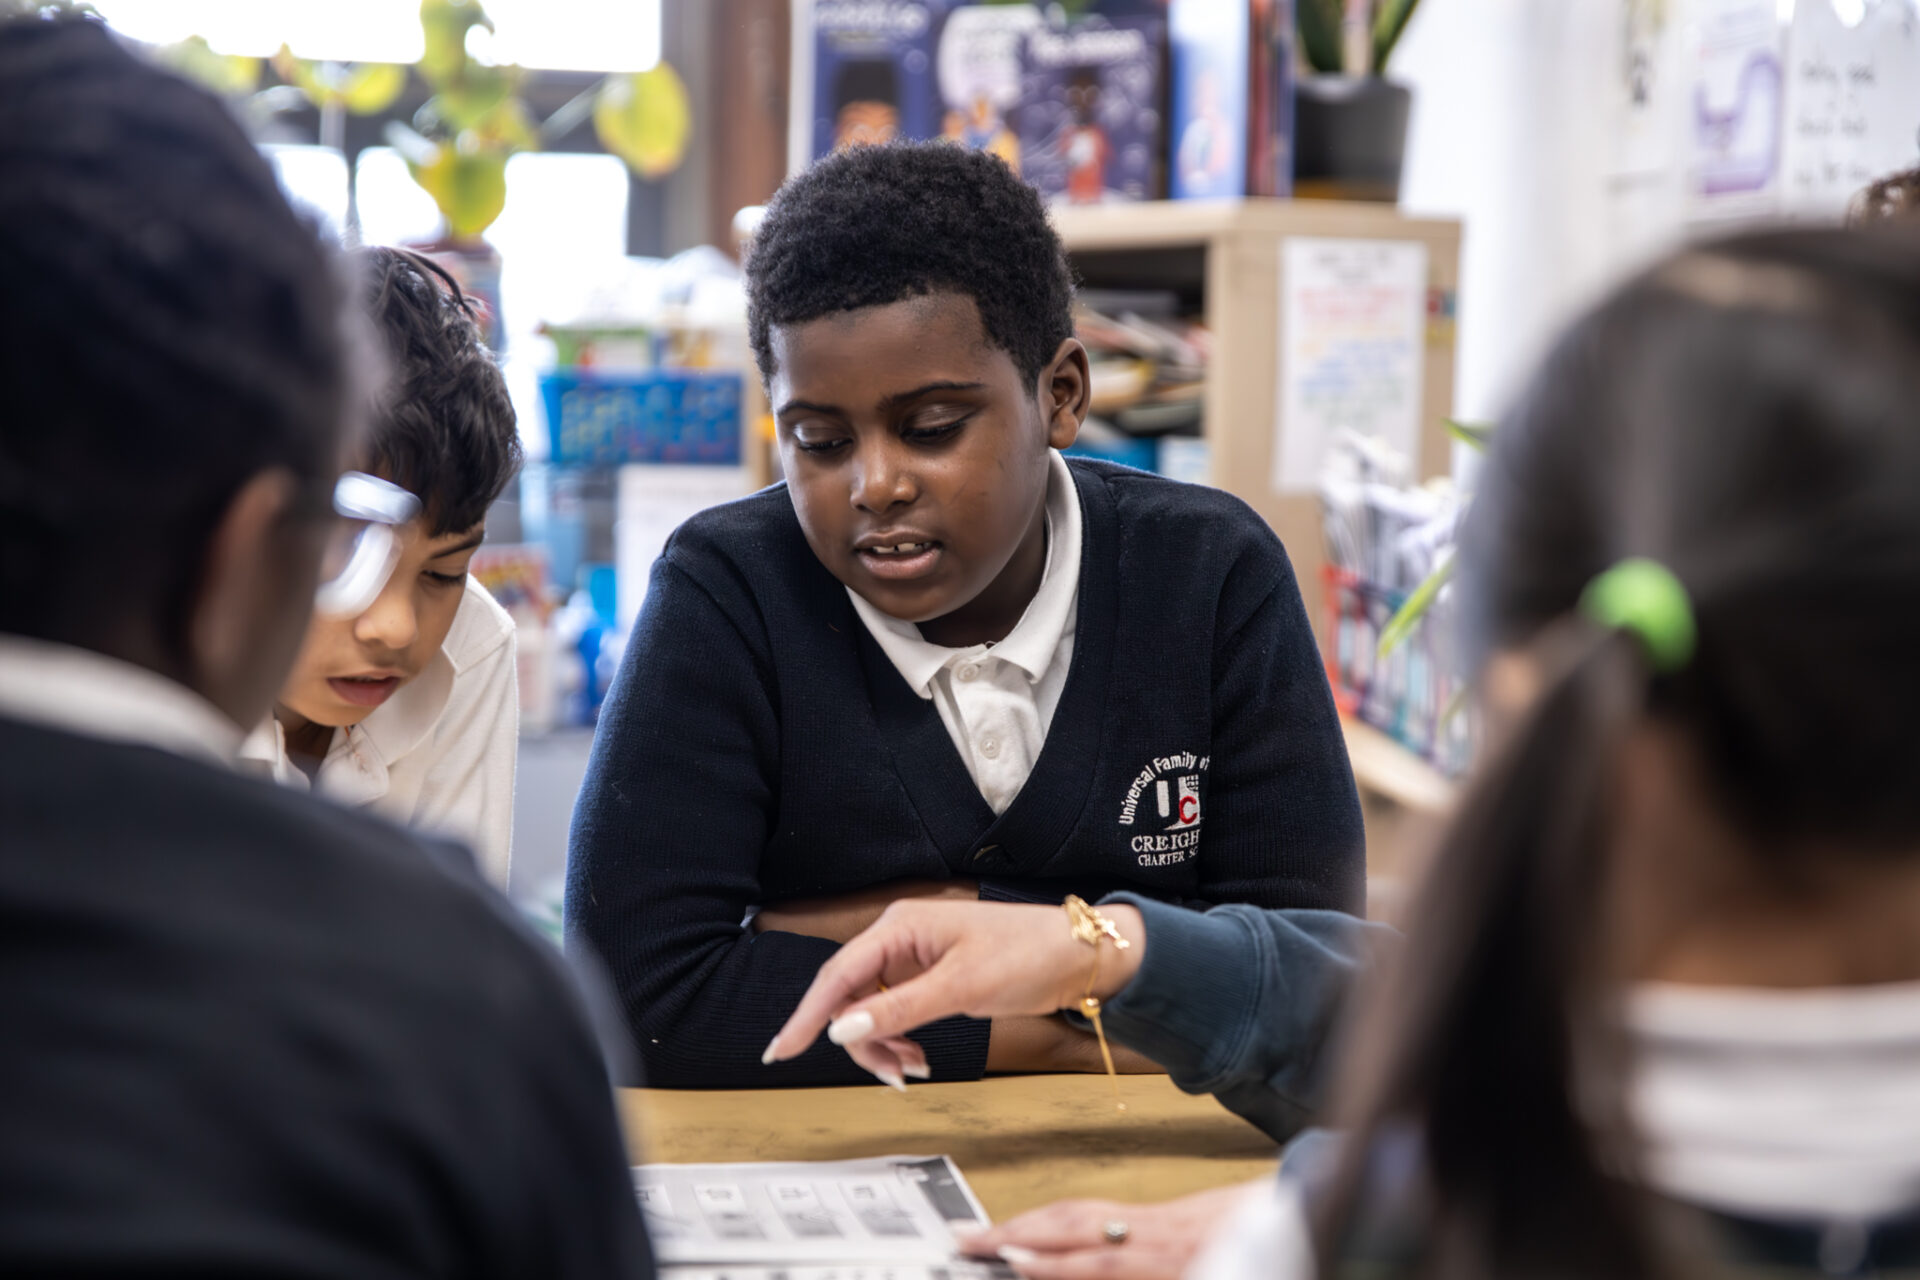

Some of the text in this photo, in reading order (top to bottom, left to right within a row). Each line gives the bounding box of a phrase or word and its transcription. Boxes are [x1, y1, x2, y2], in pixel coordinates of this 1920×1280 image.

[1118, 765, 1156, 825] Universal
[1153, 750, 1198, 774] Family
[1138, 850, 1185, 867] CHARTER
